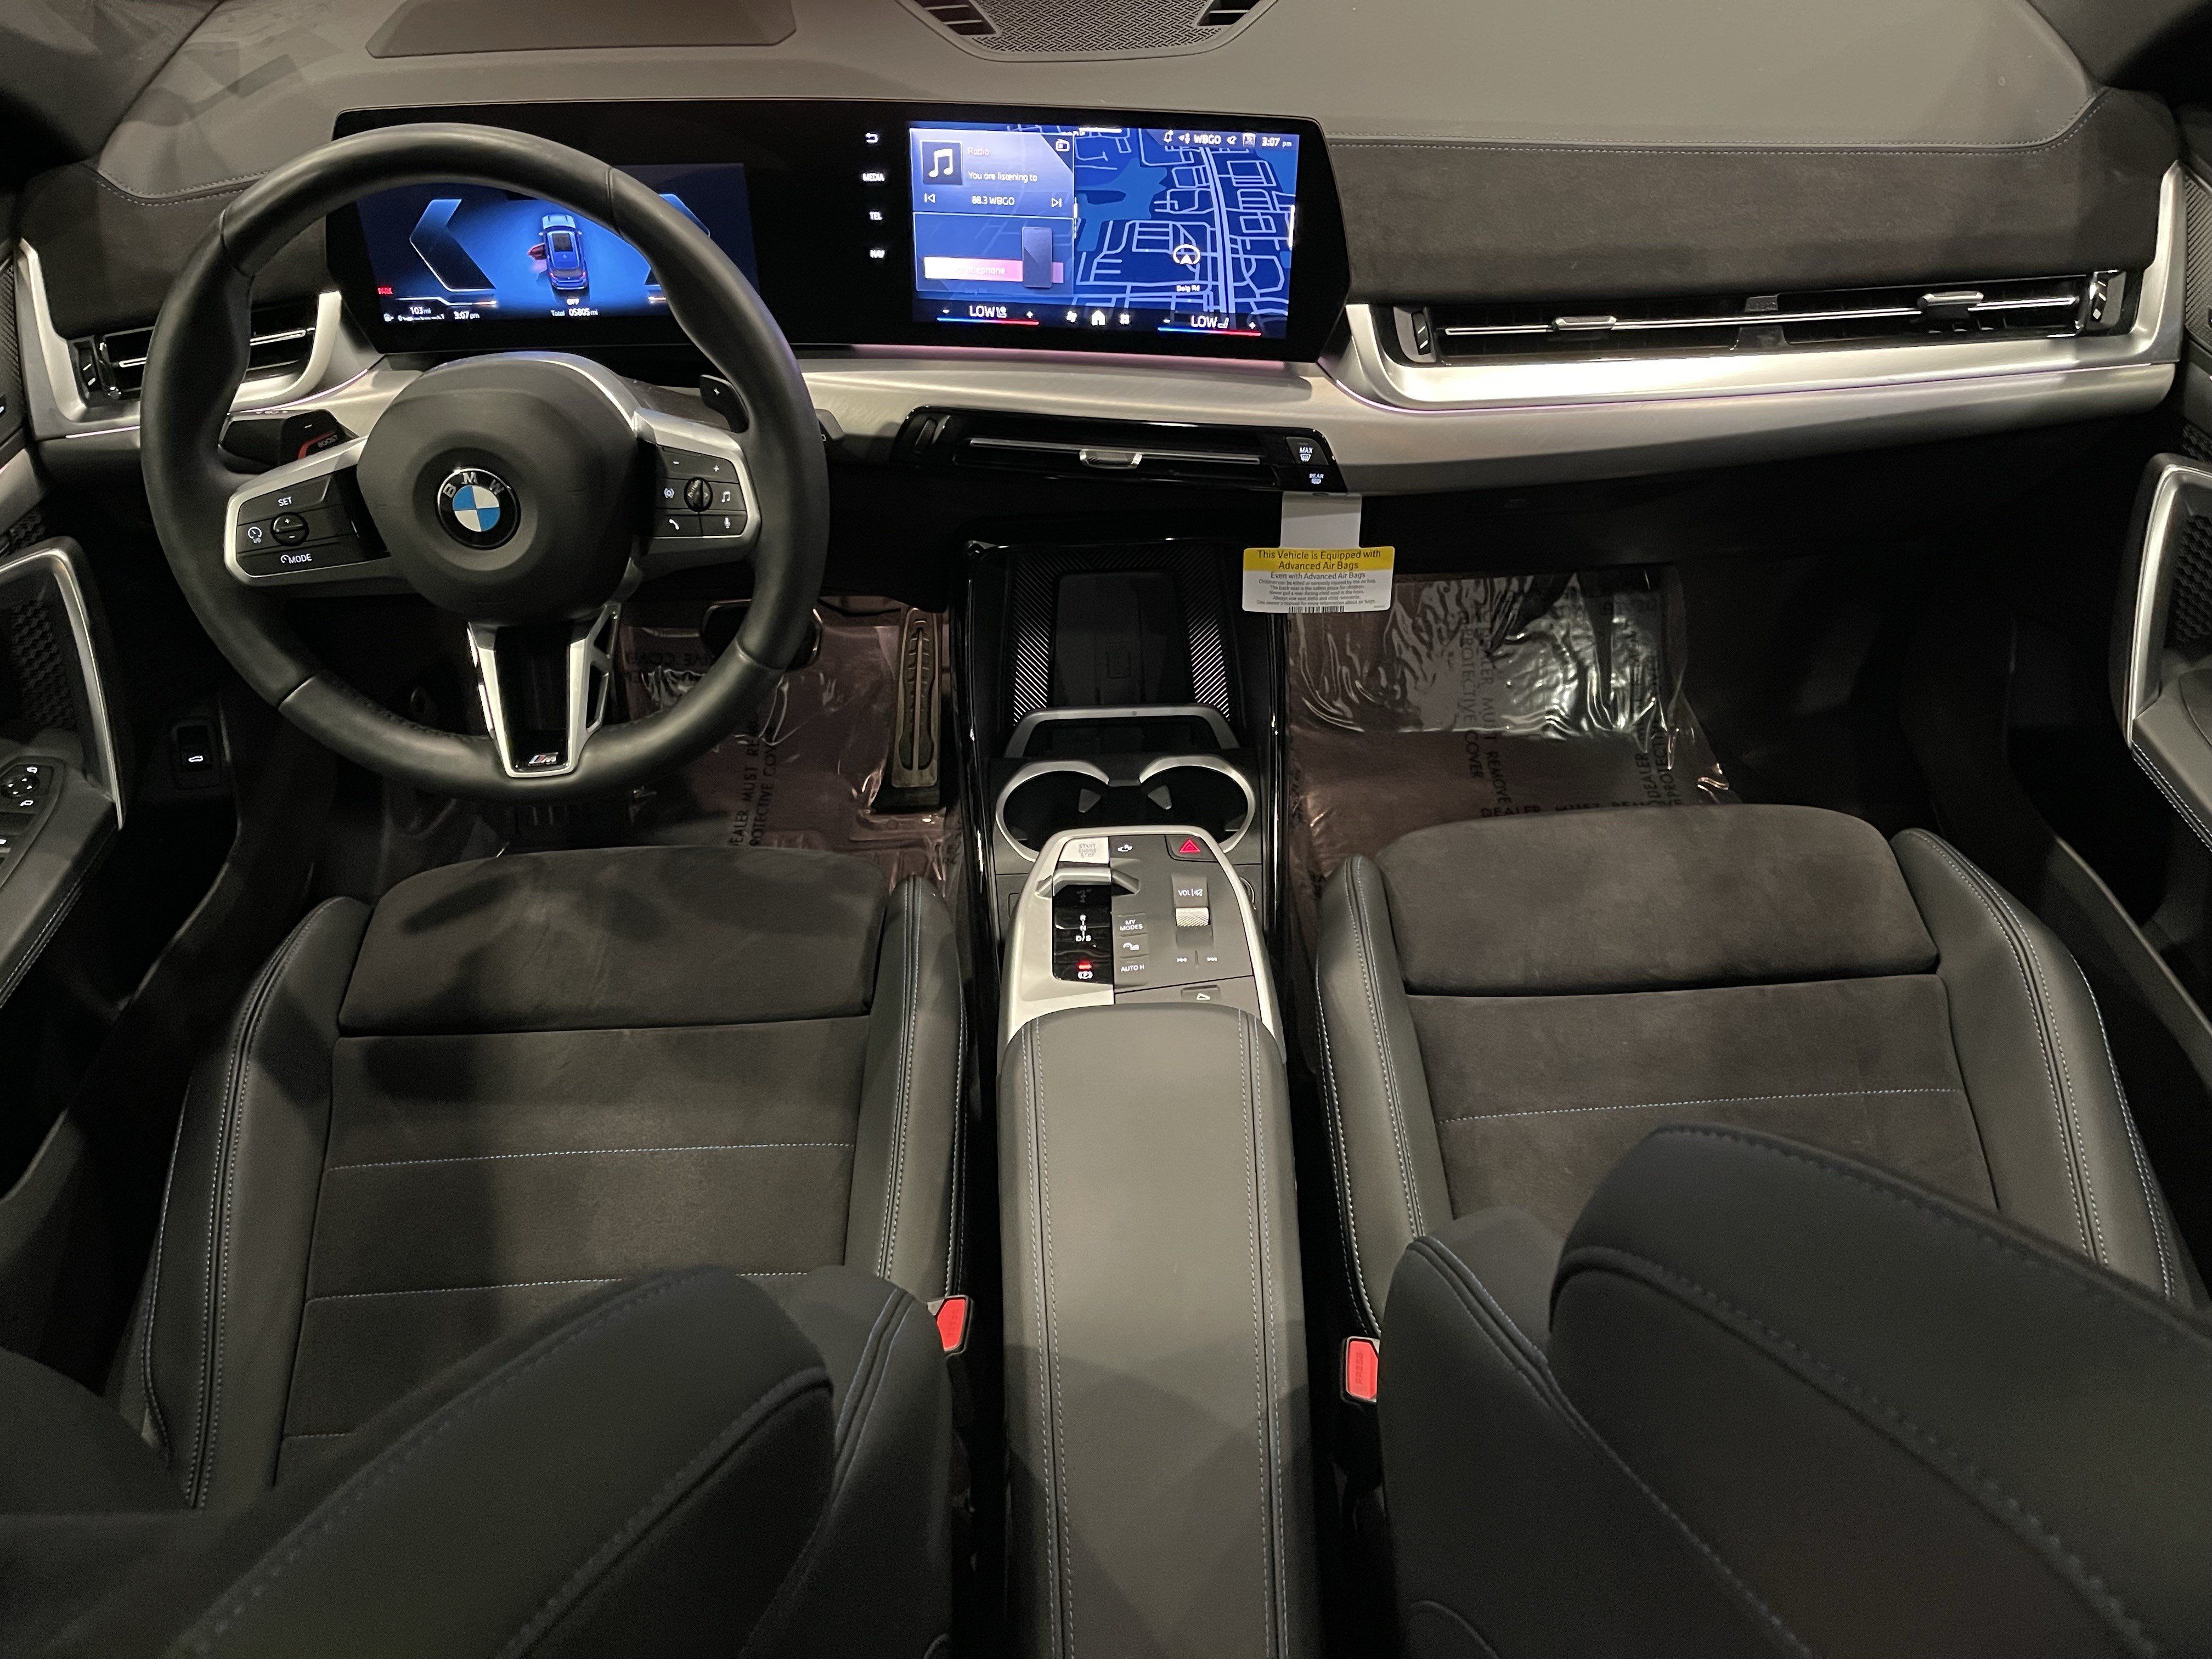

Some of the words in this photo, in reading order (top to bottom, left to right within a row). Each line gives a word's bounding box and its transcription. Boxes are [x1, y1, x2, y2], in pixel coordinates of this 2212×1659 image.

[1261, 136, 1280, 146] 3:07
[968, 146, 990, 156] Radio
[862, 173, 885, 182] MEDIA
[968, 171, 982, 180] You
[997, 172, 1029, 183] listening
[1030, 173, 1037, 182] to
[971, 195, 988, 204] 88.3
[989, 196, 1014, 205] WBGO
[969, 306, 996, 318] LOW
[1190, 315, 1218, 328] LOW
[317, 435, 338, 448] BOOST
[442, 472, 505, 498] BMW
[278, 496, 292, 506] SET
[289, 554, 312, 563] MODE
[1257, 550, 1276, 558] This
[1278, 550, 1309, 560] Vehicle
[1311, 550, 1318, 560] is
[1321, 550, 1361, 561] Equipped
[1363, 549, 1381, 558] with
[1278, 561, 1321, 570] Advanced
[1322, 561, 1335, 569] Air
[1338, 561, 1358, 571] Bags
[1482, 697, 1498, 740] MUT
[1465, 731, 1483, 778] COVER
[730, 810, 749, 845] EALER
[742, 768, 758, 802] MUST
